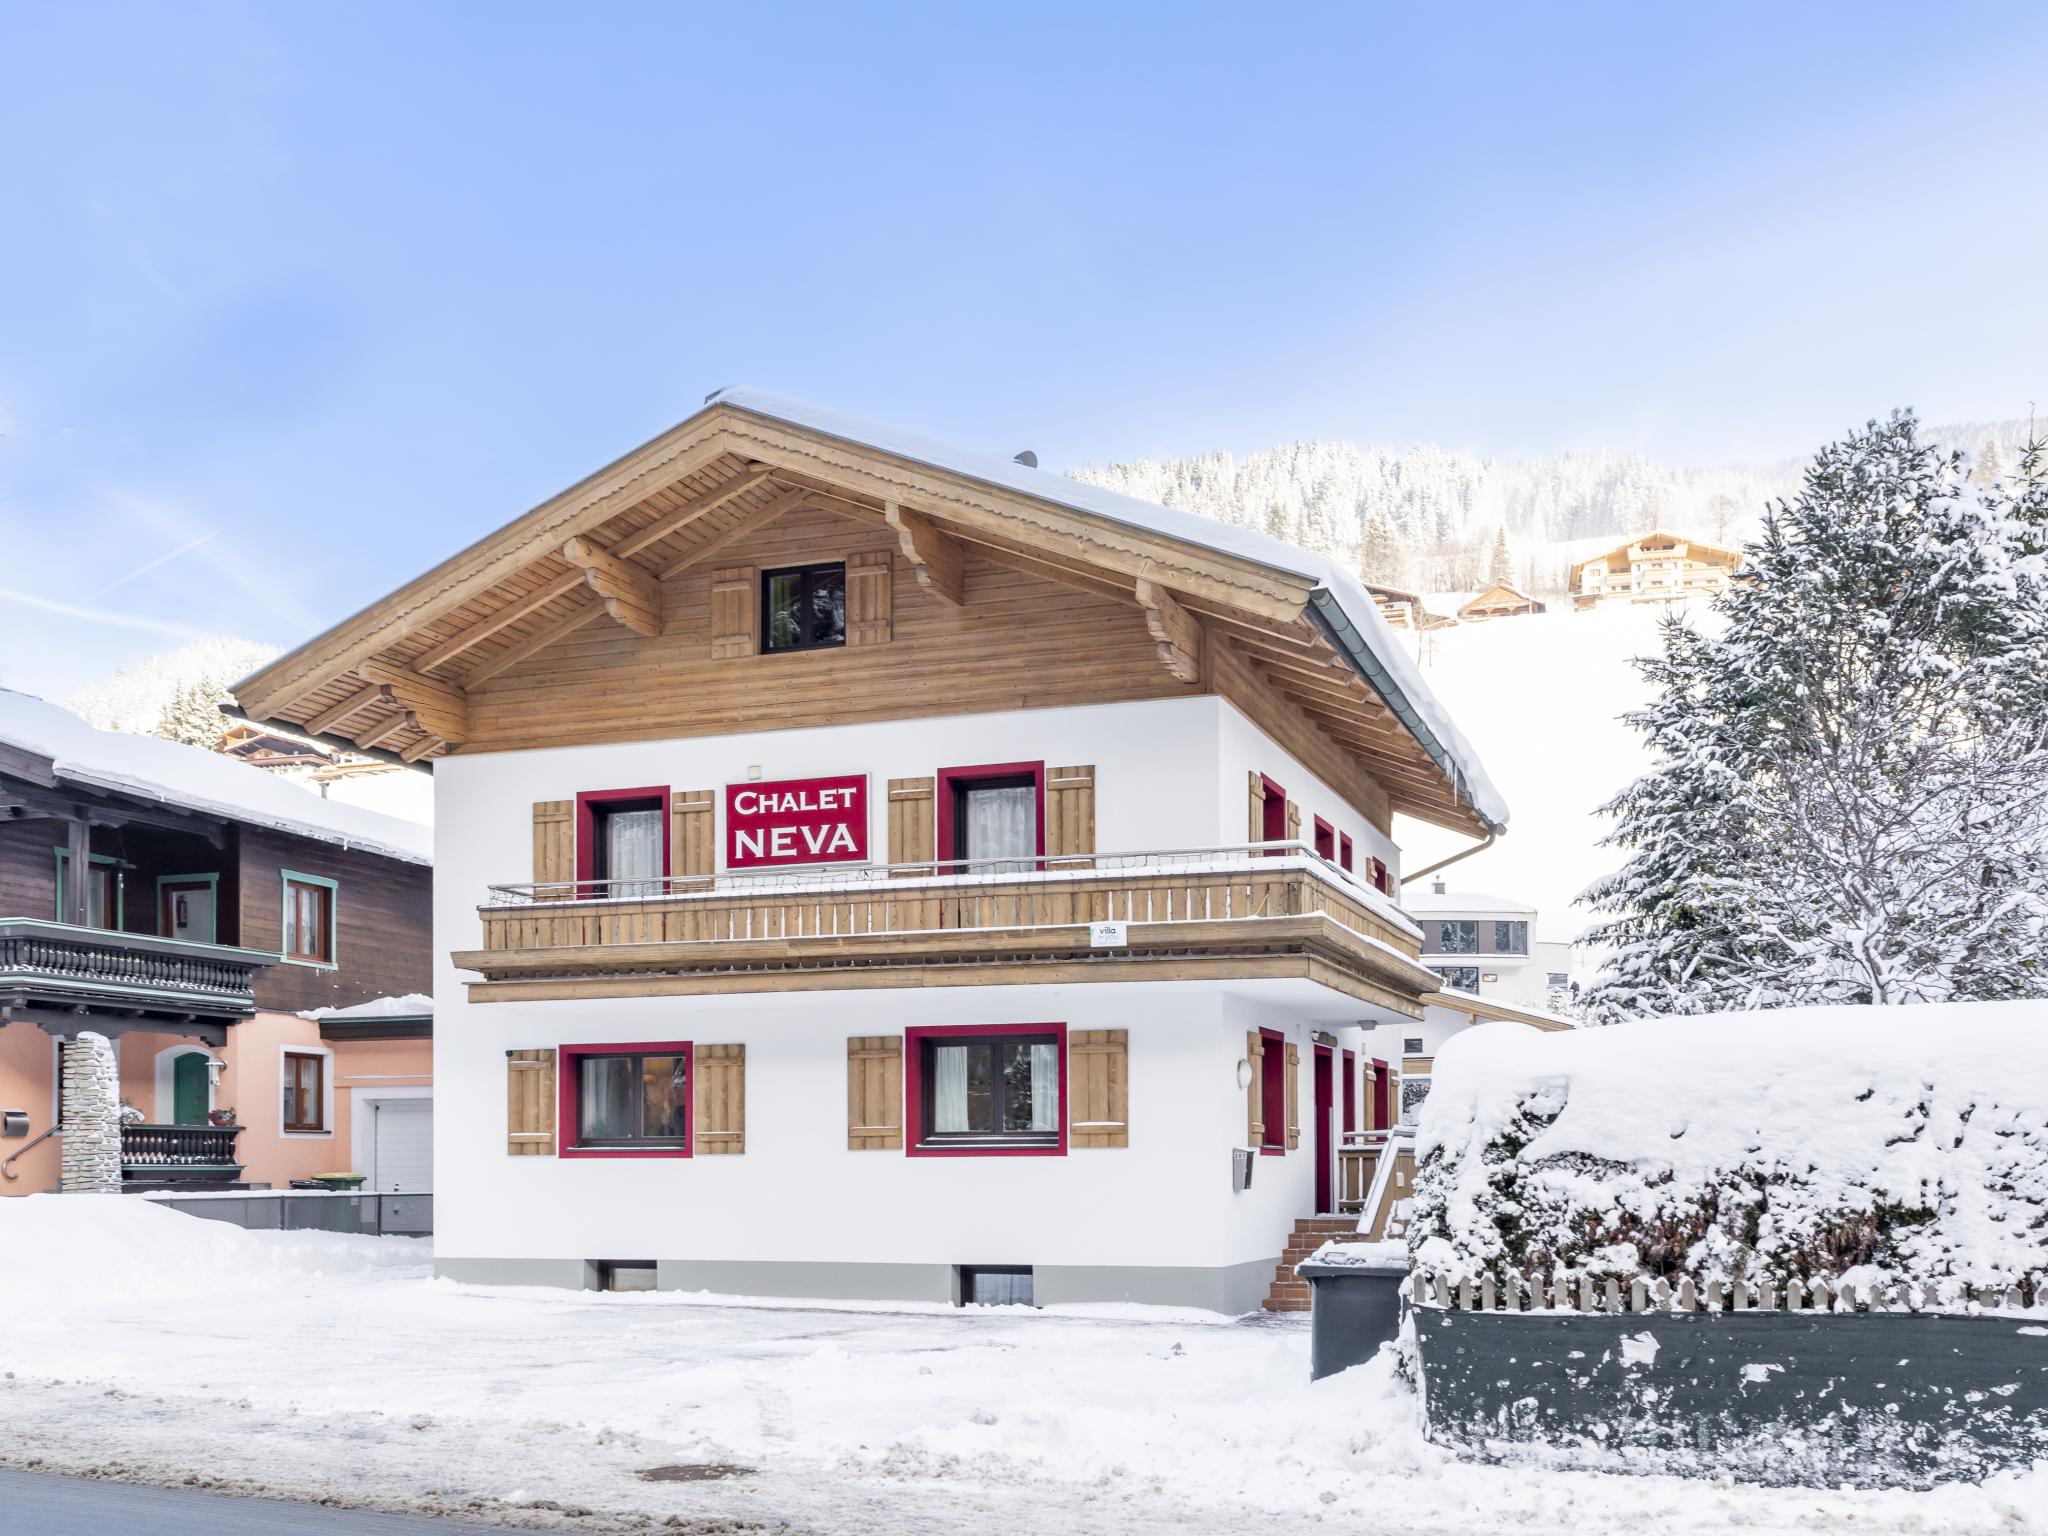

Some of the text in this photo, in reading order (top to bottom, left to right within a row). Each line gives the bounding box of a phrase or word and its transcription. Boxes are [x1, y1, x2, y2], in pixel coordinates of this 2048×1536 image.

[734, 787, 856, 815] CHALET
[734, 823, 858, 859] NEVA
[1099, 926, 1116, 934] villa
